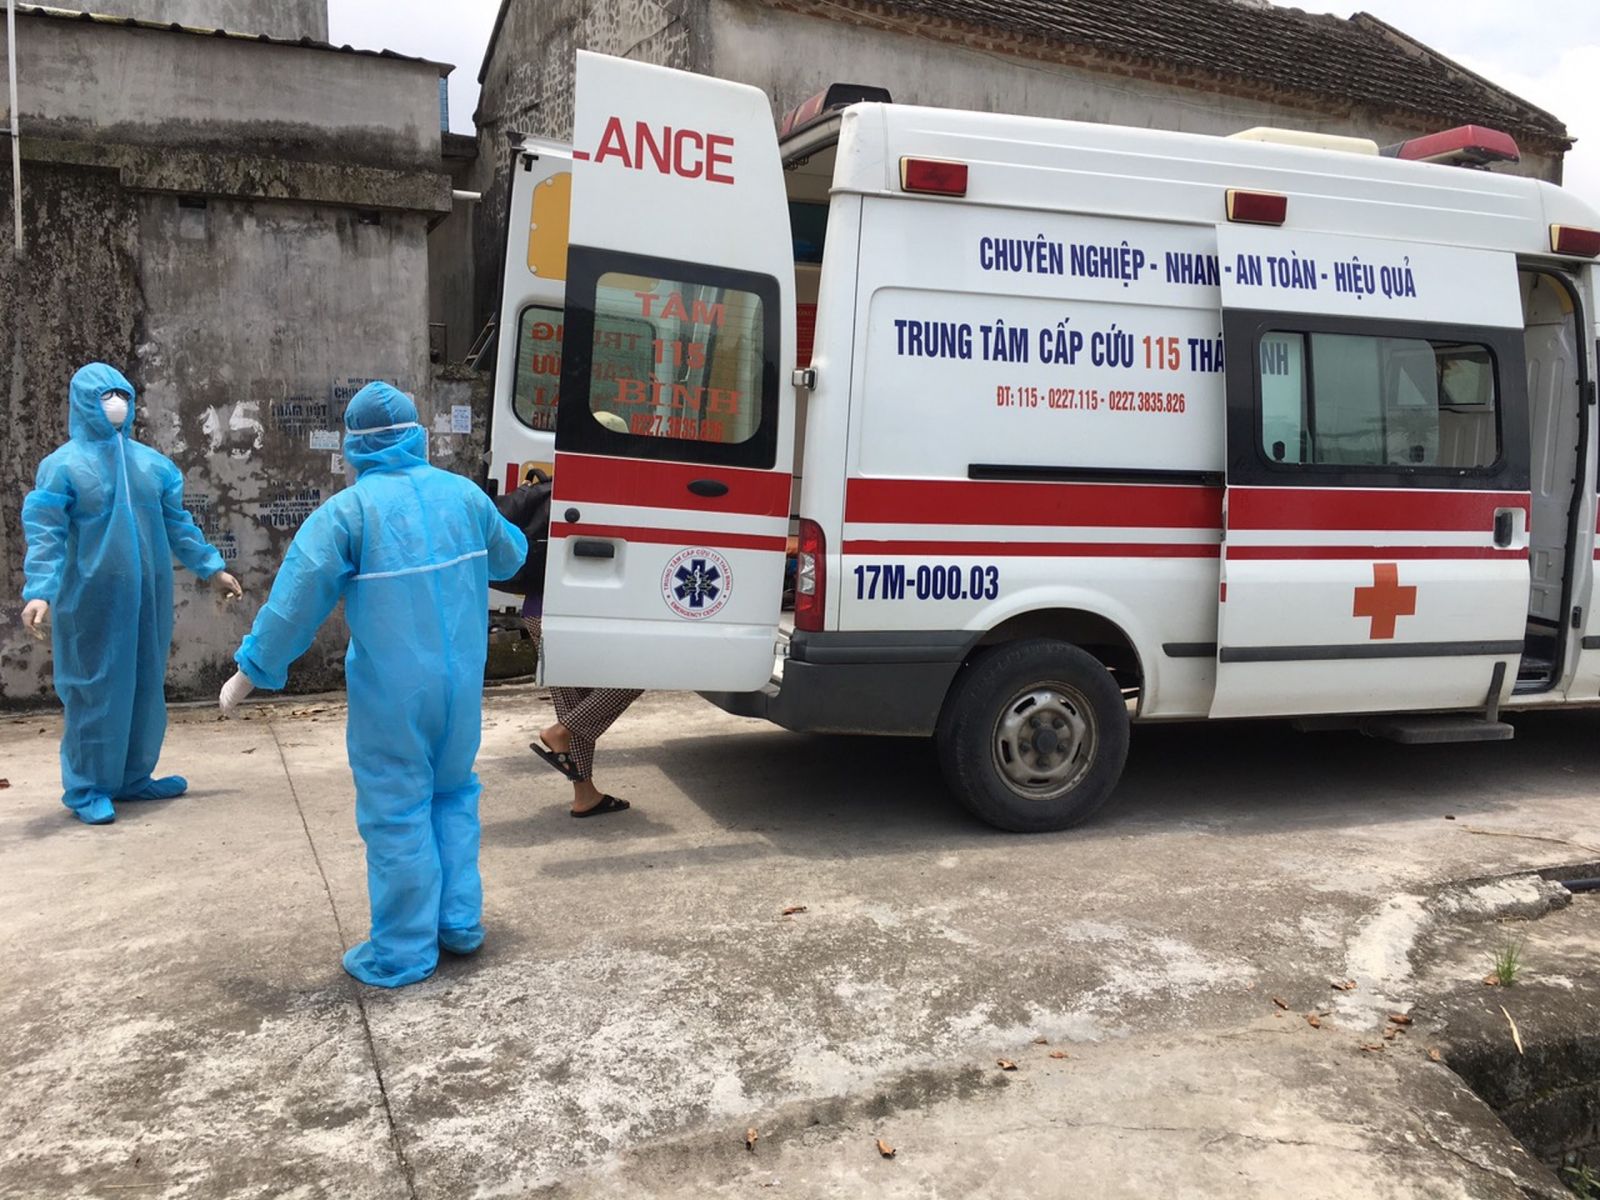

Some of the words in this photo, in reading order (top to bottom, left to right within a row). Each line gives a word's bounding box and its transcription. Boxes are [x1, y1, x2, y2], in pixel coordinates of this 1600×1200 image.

[573, 116, 734, 185] ANCE
[980, 234, 1063, 275] CHUYÊN
[1070, 241, 1144, 287] NGHIỆP
[1165, 251, 1220, 286] NHAN
[1236, 254, 1263, 286] AN
[1267, 250, 1317, 290] TOÀN
[1334, 256, 1375, 300] HIỆU
[1380, 256, 1416, 299] QUẢ
[635, 291, 725, 327] TÂM
[653, 338, 705, 369] 115
[894, 319, 972, 359] TRUNG
[980, 319, 1028, 363] TÂM
[1039, 317, 1083, 365] CẤP
[1091, 323, 1134, 368] CỨU
[1143, 335, 1180, 370] 115
[1187, 332, 1224, 372] THÁ
[613, 372, 742, 416] BÌNH
[996, 385, 1014, 406] ĐT:
[1018, 387, 1037, 407] 115
[1048, 388, 1098, 410] 0227.115
[1109, 390, 1185, 413] 0227.3835.826
[854, 564, 999, 601] 17M-000.03
